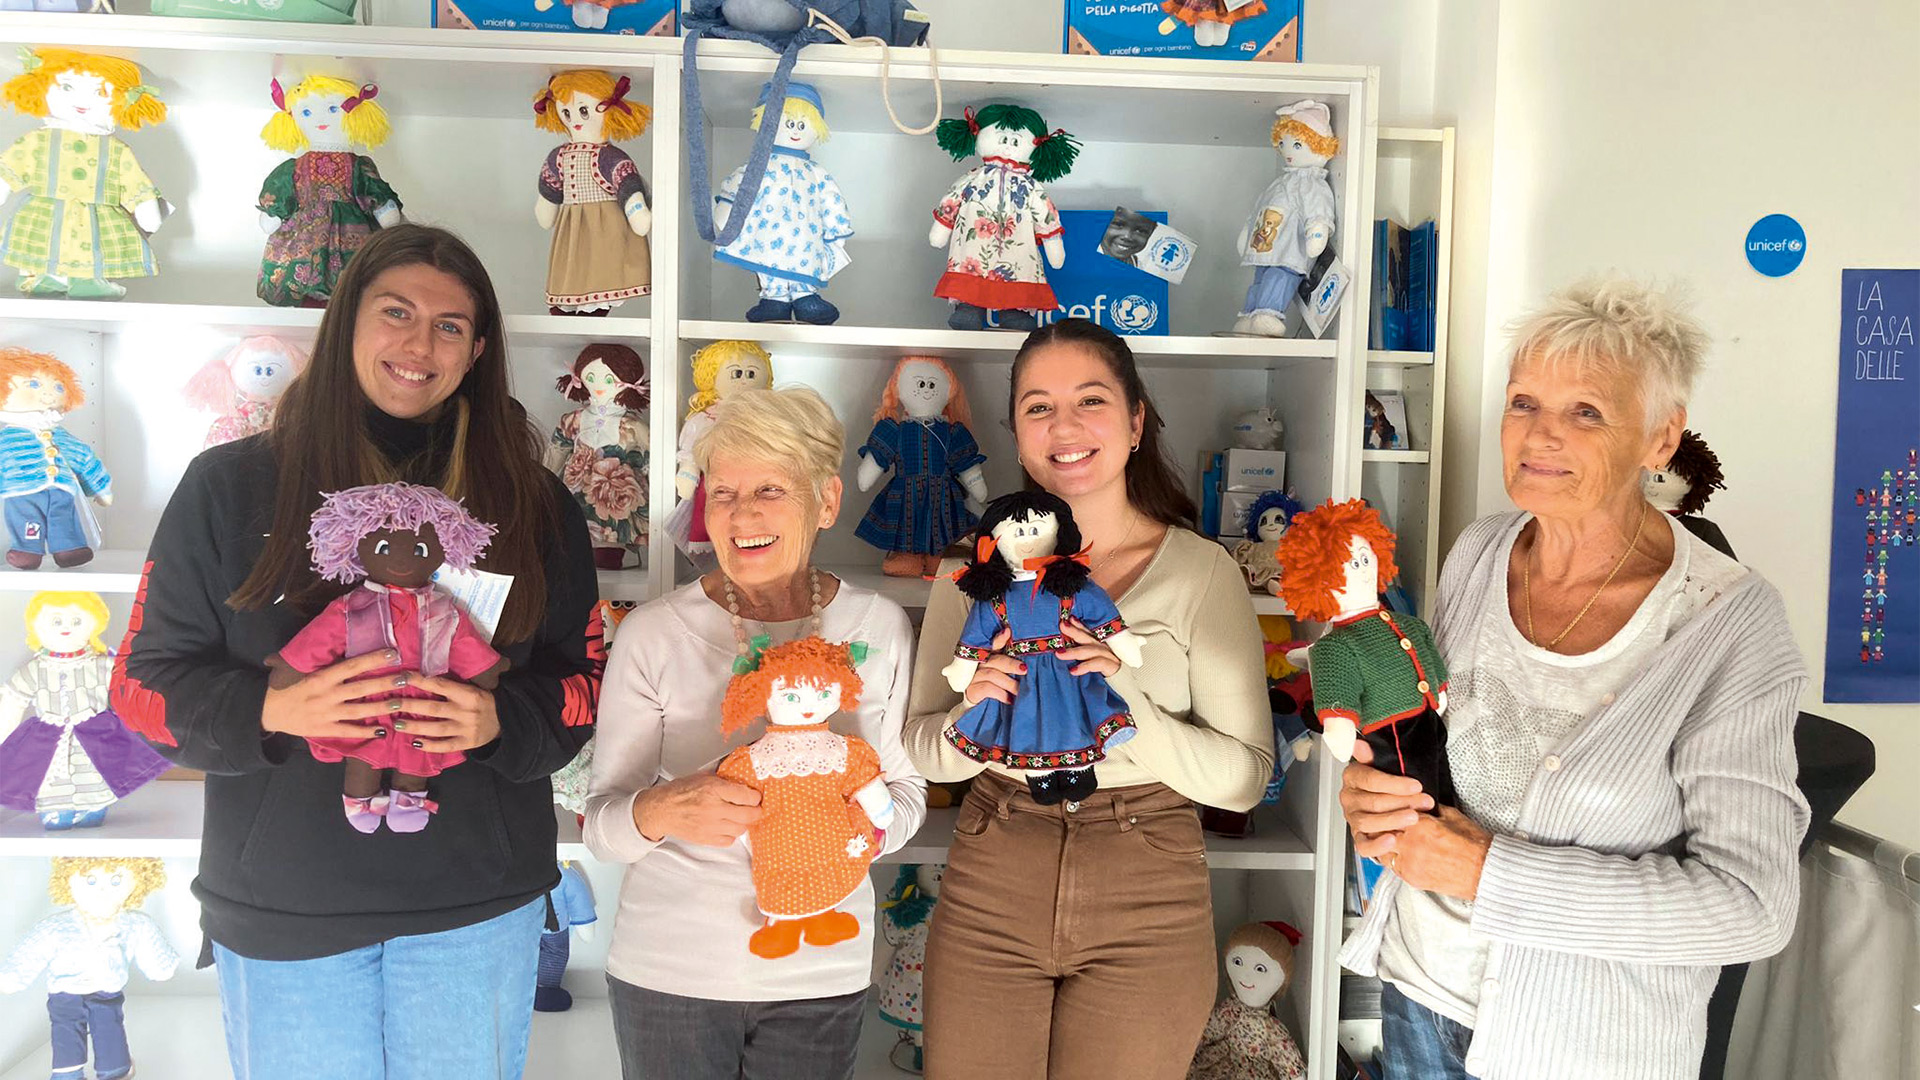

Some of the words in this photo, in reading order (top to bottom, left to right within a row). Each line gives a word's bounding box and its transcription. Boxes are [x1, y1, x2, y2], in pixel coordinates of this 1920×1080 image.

[1085, 5, 1117, 16] DELLA
[1119, 2, 1159, 14] PIGOTTA
[482, 18, 507, 27] unicef
[1109, 46, 1131, 55] unicef
[1748, 238, 1788, 252] unicef
[1857, 280, 1884, 311] LA
[986, 295, 1107, 328] uicef
[1856, 315, 1914, 346] CASA
[1855, 350, 1905, 381] DELLE
[1241, 466, 1264, 476] unicef
